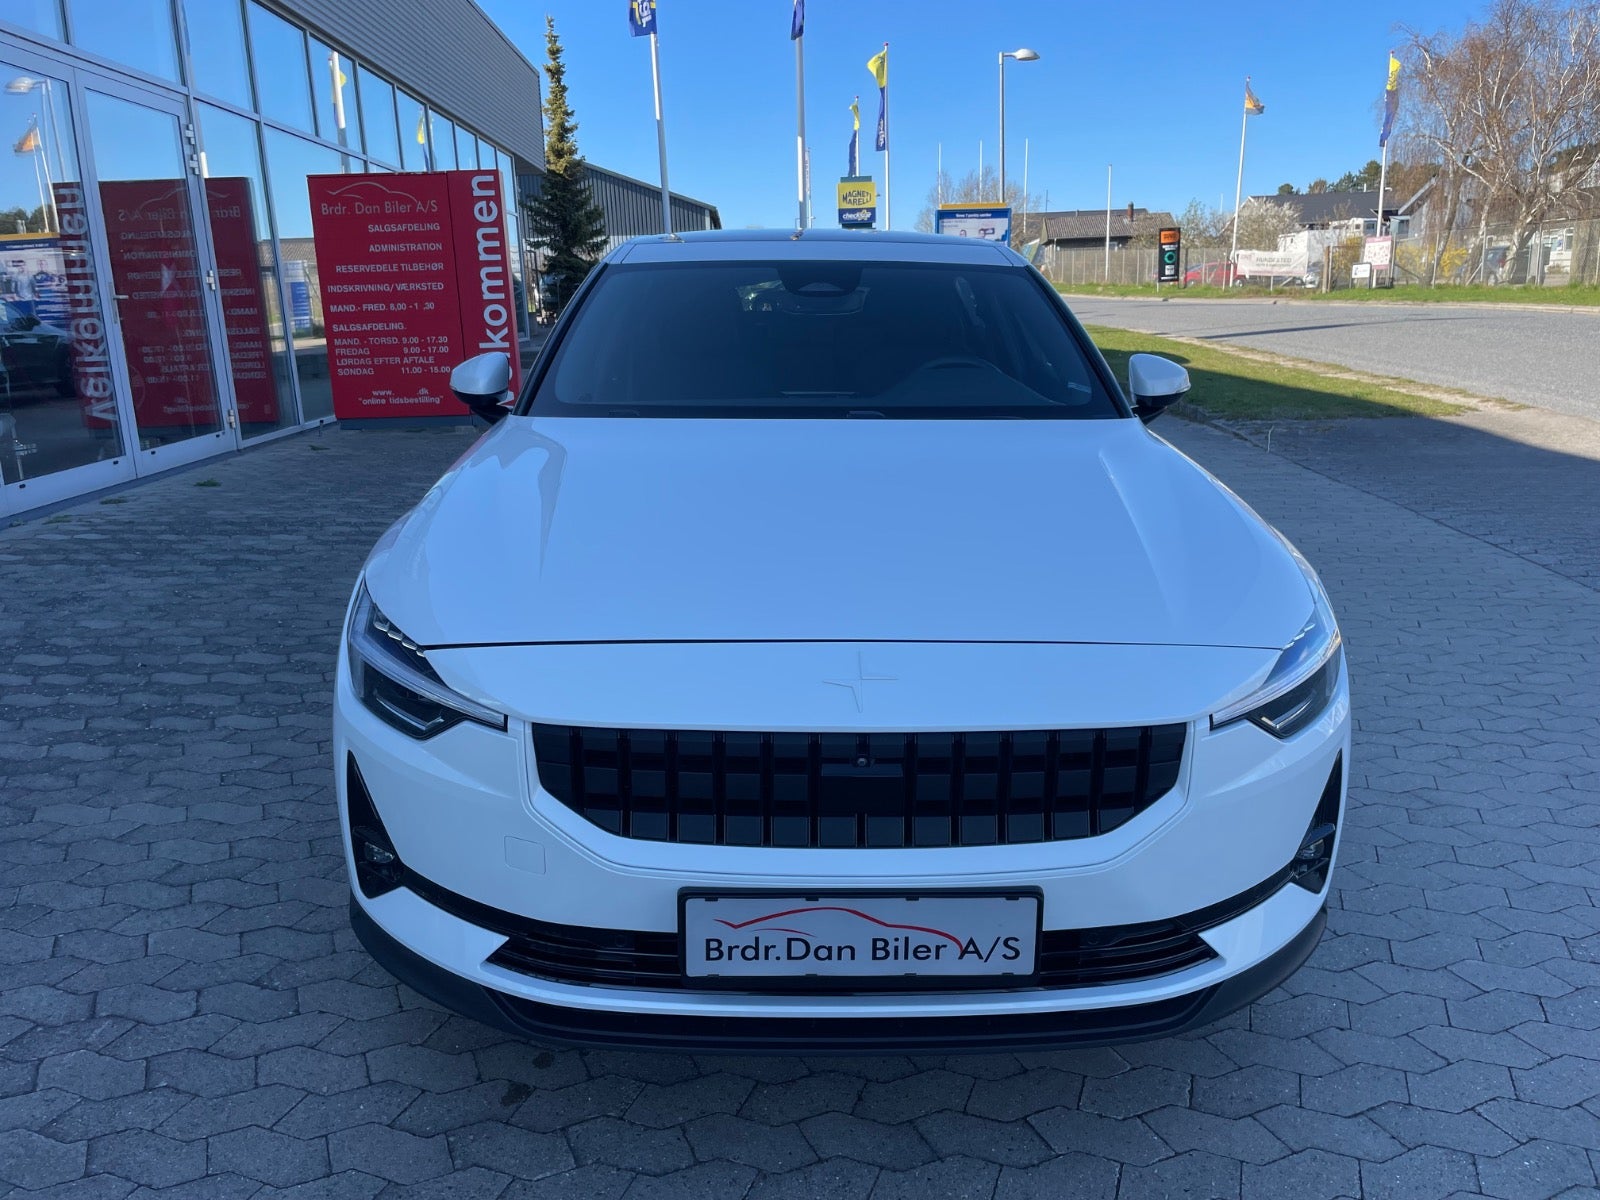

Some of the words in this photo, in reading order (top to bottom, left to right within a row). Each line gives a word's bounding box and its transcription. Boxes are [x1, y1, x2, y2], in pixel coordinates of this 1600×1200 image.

[321, 203, 351, 215] Brdr.
[355, 202, 380, 214] Dan
[384, 201, 412, 213] Biler
[416, 200, 438, 213] A/S
[368, 222, 440, 233] SALGSAFDELING
[369, 243, 442, 252] ADMINISTRATION
[336, 263, 398, 273] RESERVEDELE
[400, 263, 444, 272] TILBEHØR
[396, 282, 444, 291] VÆRKSTED
[362, 303, 388, 311] FRED.
[334, 338, 361, 346] MAND.
[402, 336, 419, 344] 9.00
[336, 348, 370, 356] FREDAG
[403, 346, 420, 354] 9.00
[337, 358, 372, 366] LØRDAG
[403, 356, 435, 364] AFTALE
[872, 936, 948, 962] Biler
[958, 936, 1021, 963] A/S
